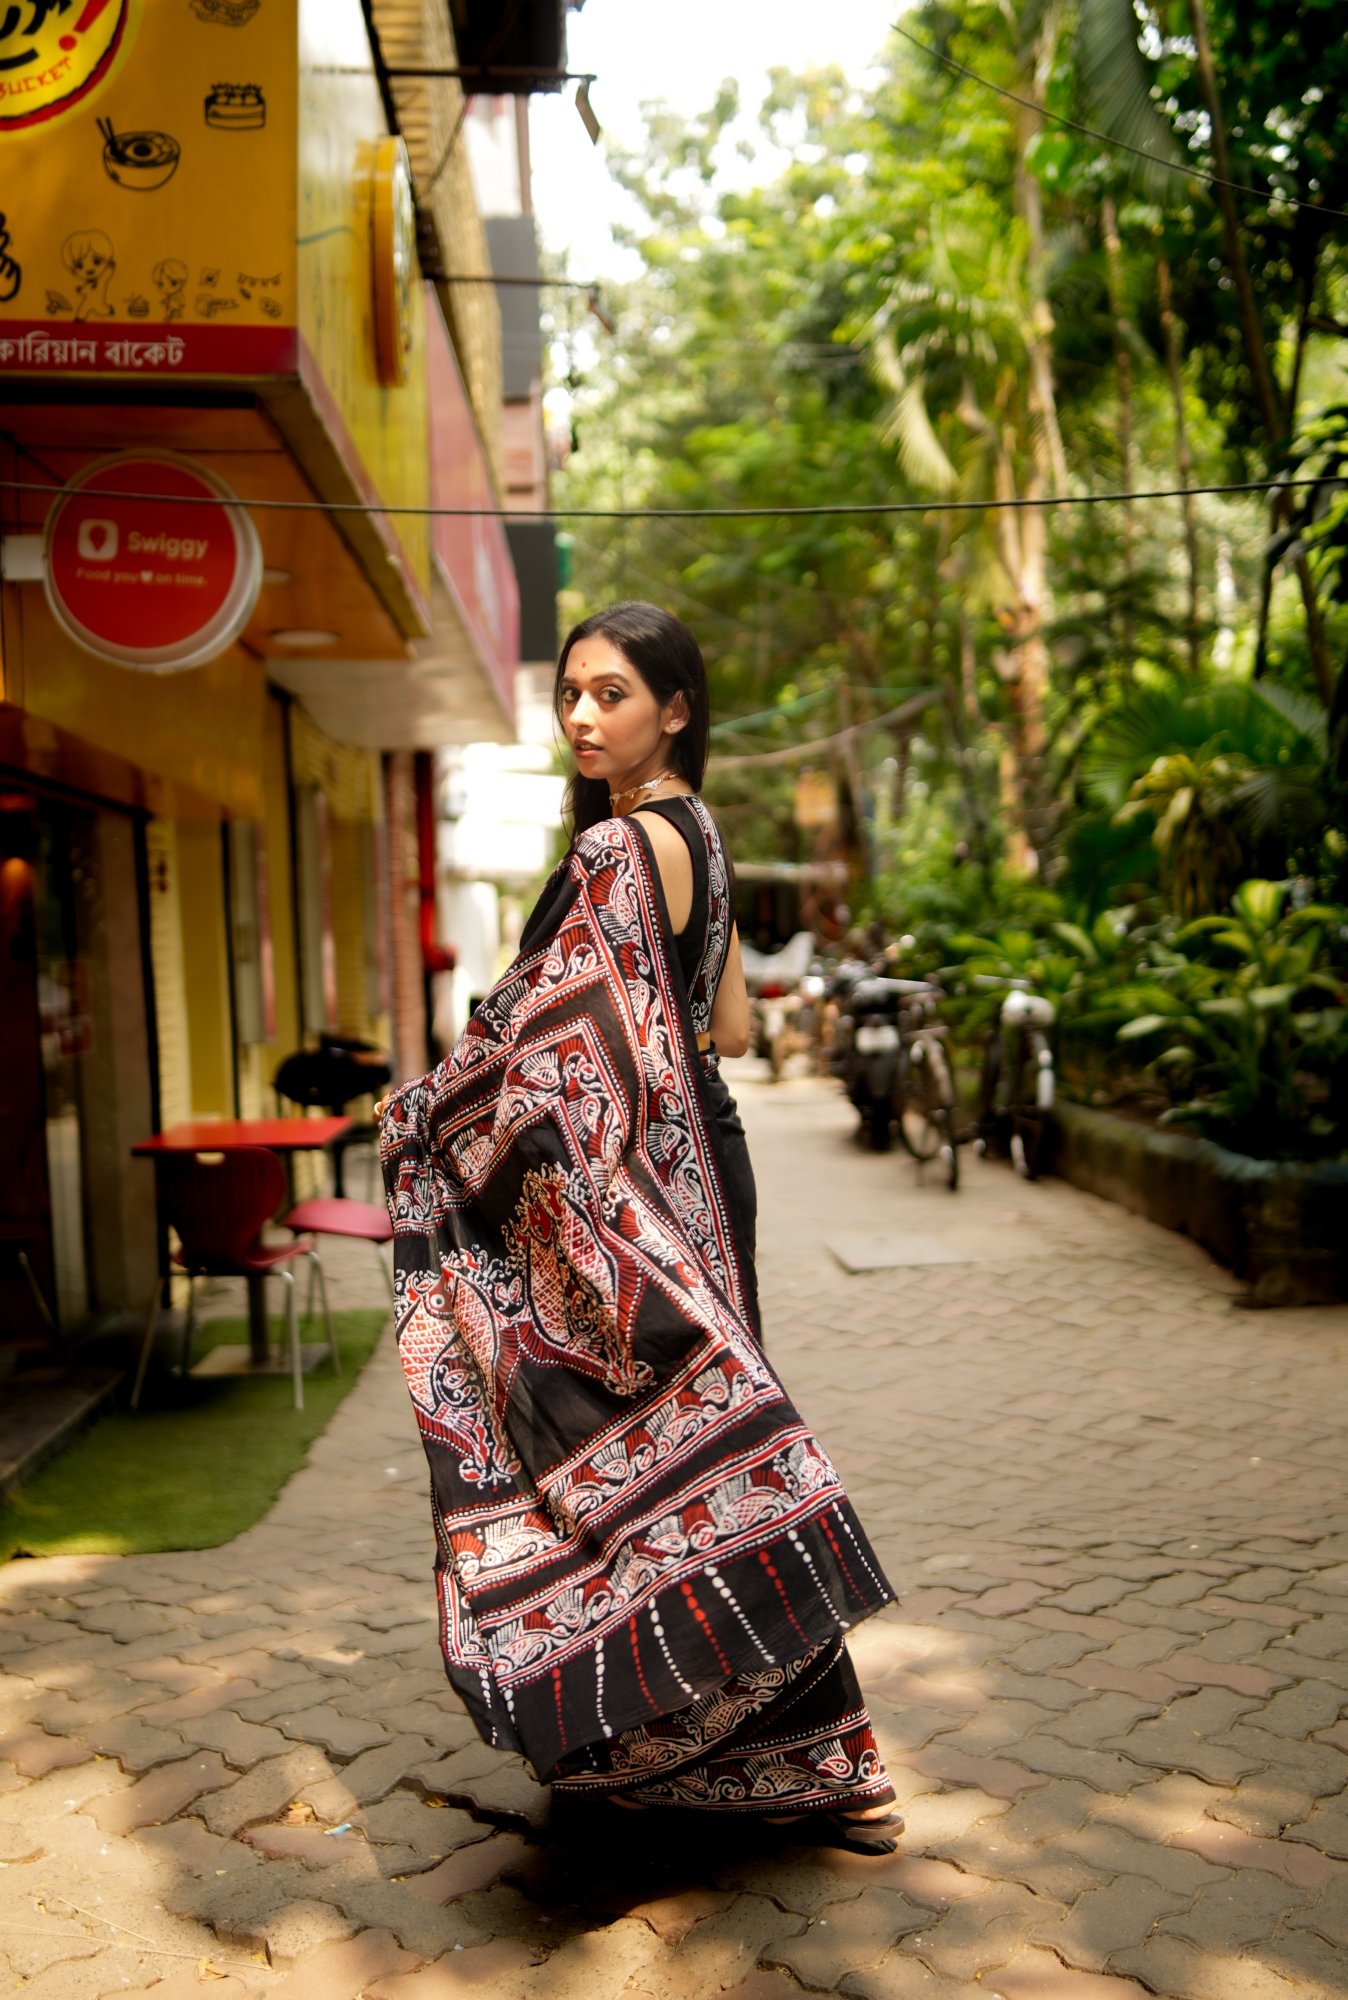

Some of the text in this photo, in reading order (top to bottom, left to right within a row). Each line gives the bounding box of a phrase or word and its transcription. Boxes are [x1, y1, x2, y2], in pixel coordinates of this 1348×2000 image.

[104, 334, 186, 367] বাকেট
[128, 530, 208, 561] Swiggy
[76, 566, 111, 581] Food
[114, 571, 138, 584] you
[156, 572, 172, 584] on
